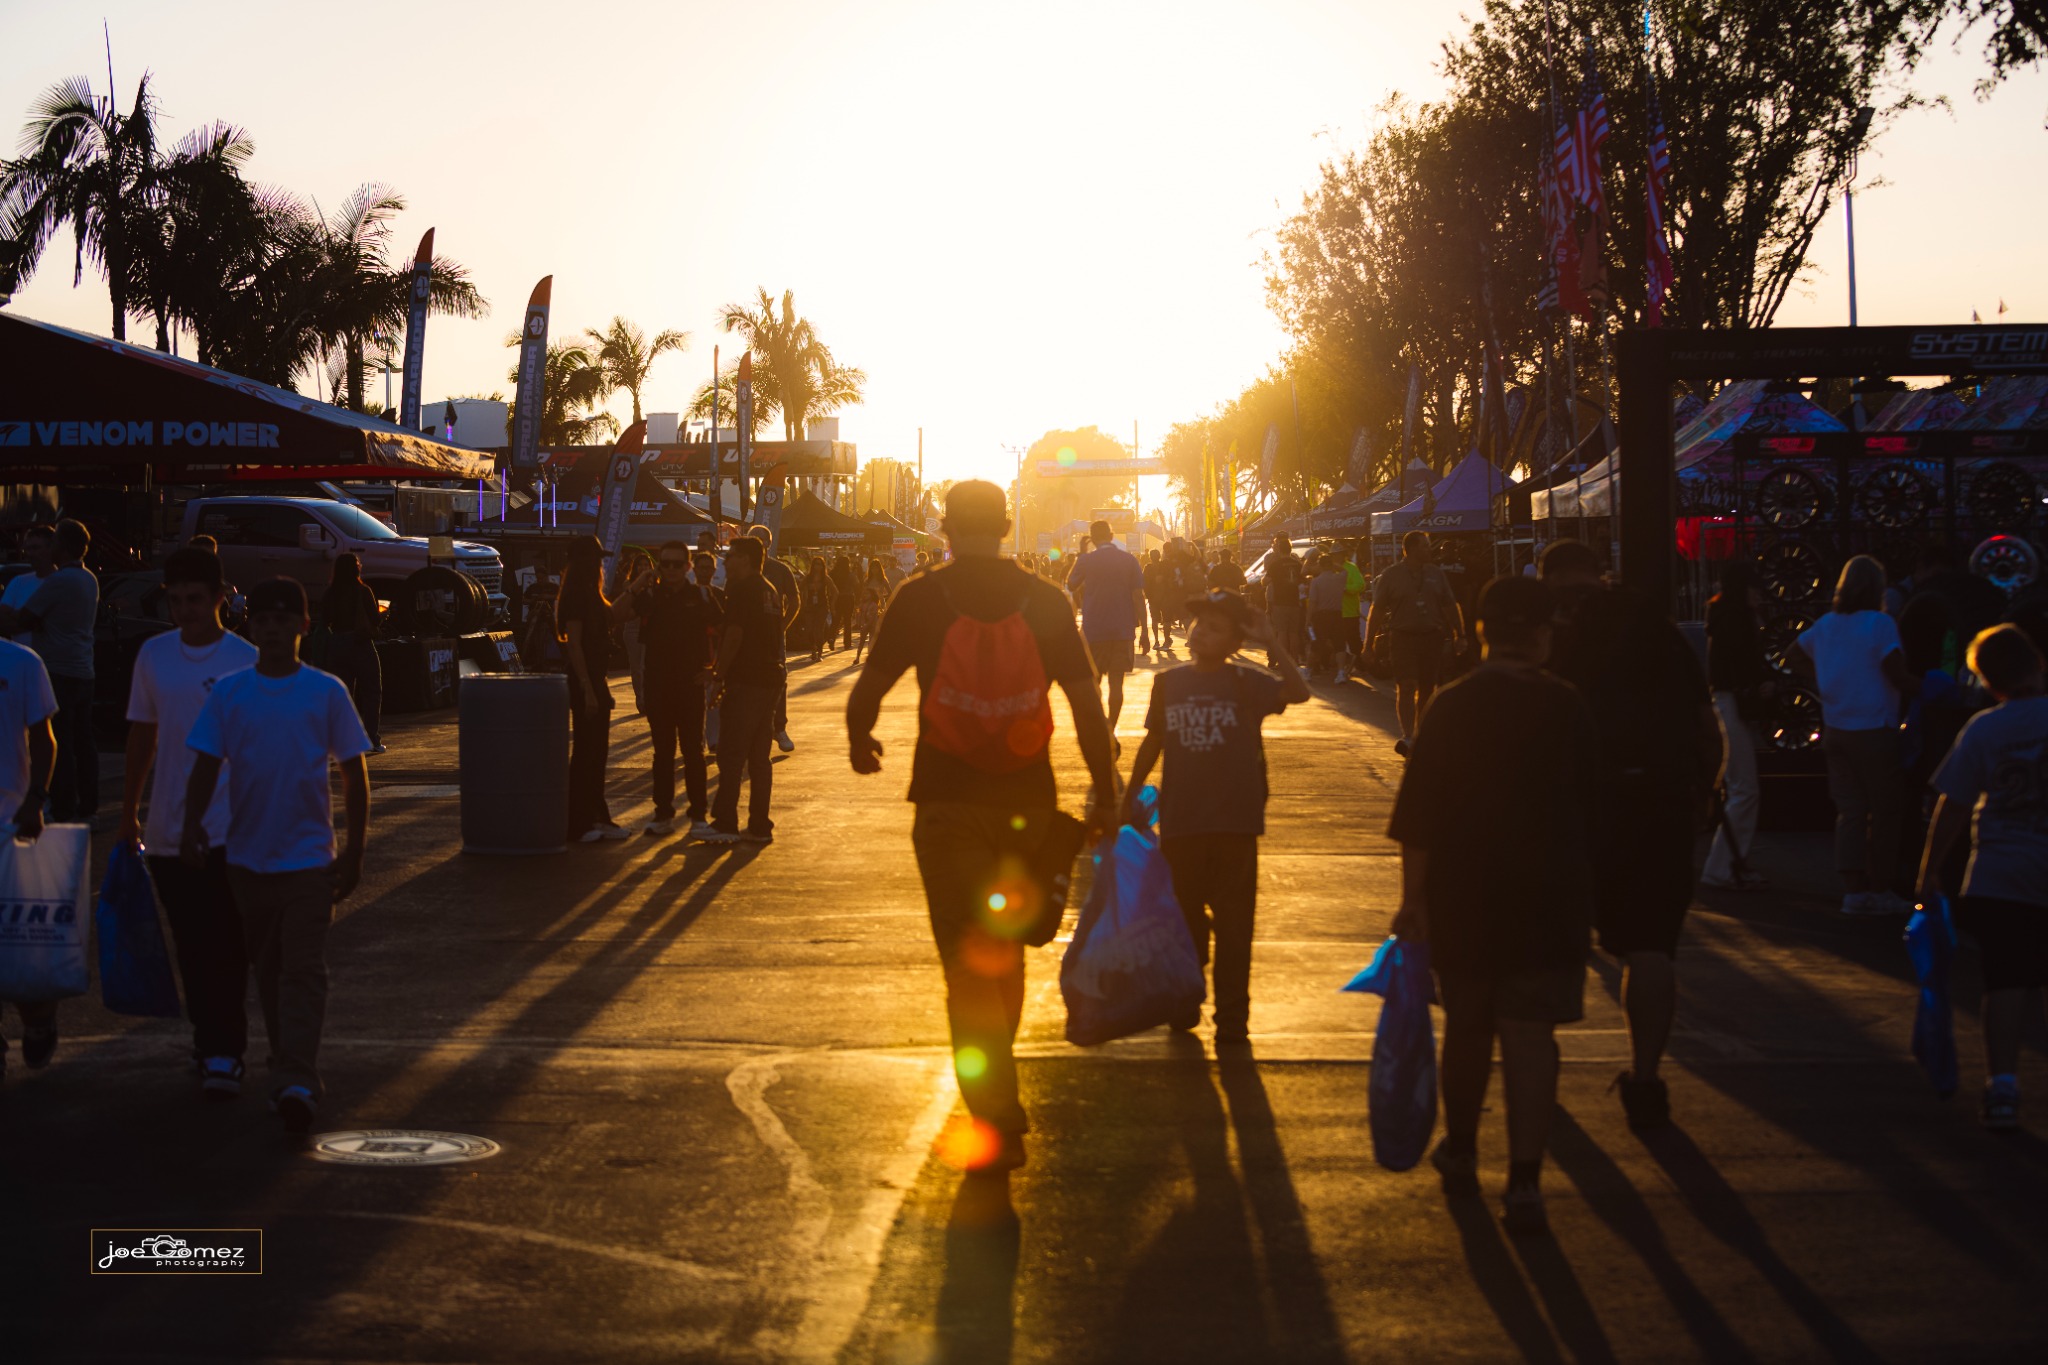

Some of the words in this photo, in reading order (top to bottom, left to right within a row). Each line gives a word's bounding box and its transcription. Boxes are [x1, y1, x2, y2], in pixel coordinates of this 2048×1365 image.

[409, 310, 423, 395] ARMOR
[1911, 332, 2048, 353] SYSTEM
[522, 345, 538, 418] ARMOR
[35, 420, 153, 447] VENOM
[162, 421, 280, 449] POWER
[519, 419, 532, 461] PRO
[533, 501, 578, 512] PRO
[1416, 515, 1463, 527] AGM
[1180, 726, 1225, 747] USA
